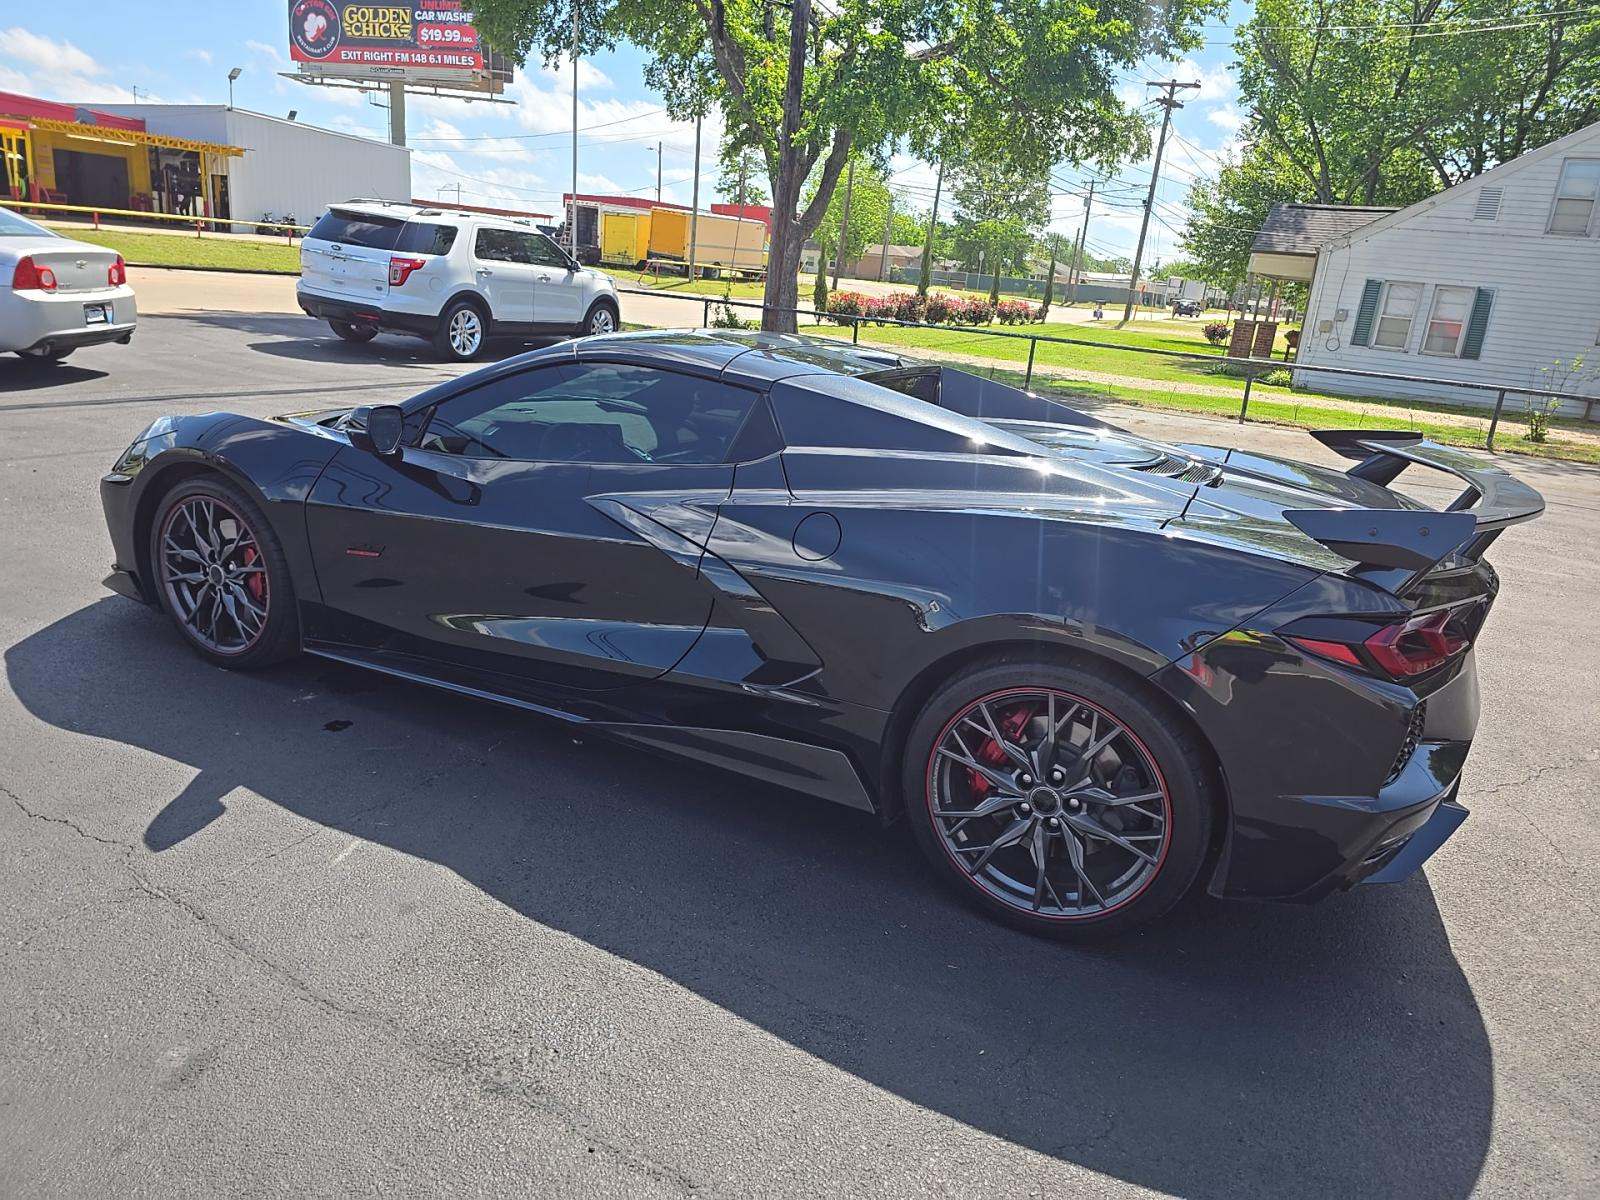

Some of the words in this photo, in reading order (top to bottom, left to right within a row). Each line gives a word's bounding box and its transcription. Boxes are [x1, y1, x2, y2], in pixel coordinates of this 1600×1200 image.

[420, 0, 462, 10] UNLIMIT
[344, 7, 411, 24] GOLDEN
[414, 10, 435, 21] CAR
[436, 11, 474, 23] WASHE
[351, 22, 404, 38] CHICK
[341, 50, 361, 61] EXIT
[363, 51, 393, 62] RIGHT
[395, 52, 409, 63] FM
[411, 53, 427, 64] 148
[429, 54, 441, 64] 6.1
[444, 55, 475, 66] MILES
